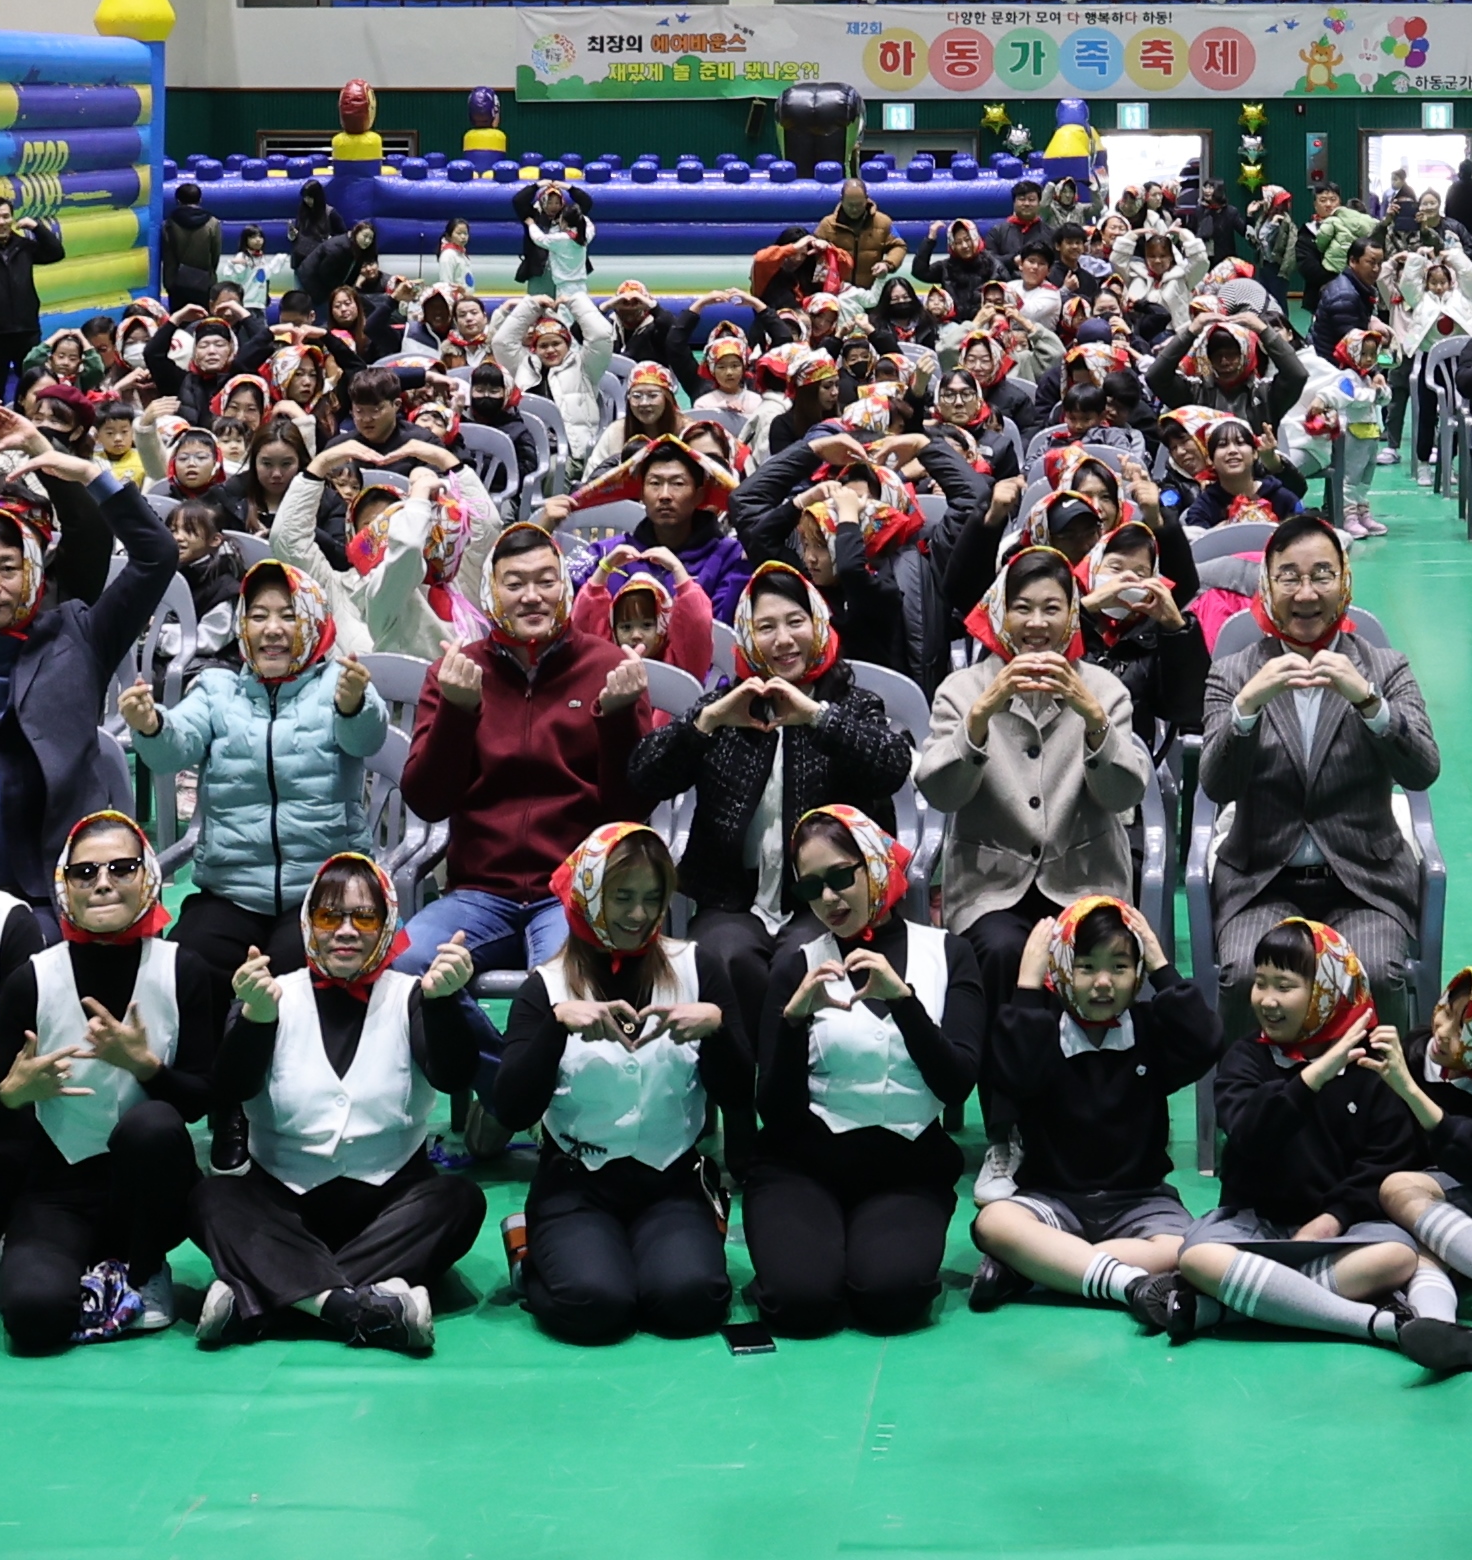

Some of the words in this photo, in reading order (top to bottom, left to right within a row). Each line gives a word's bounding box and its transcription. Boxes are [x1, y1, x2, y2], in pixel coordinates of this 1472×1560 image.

[947, 11, 986, 25] 다양한
[991, 11, 1031, 25] 문화가
[1035, 11, 1061, 25] 모여
[1067, 11, 1080, 25] 다
[1085, 11, 1138, 25] 행복하다
[1142, 11, 1173, 25] 하동!
[846, 21, 883, 36] 제2회
[699, 61, 735, 81] 준비
